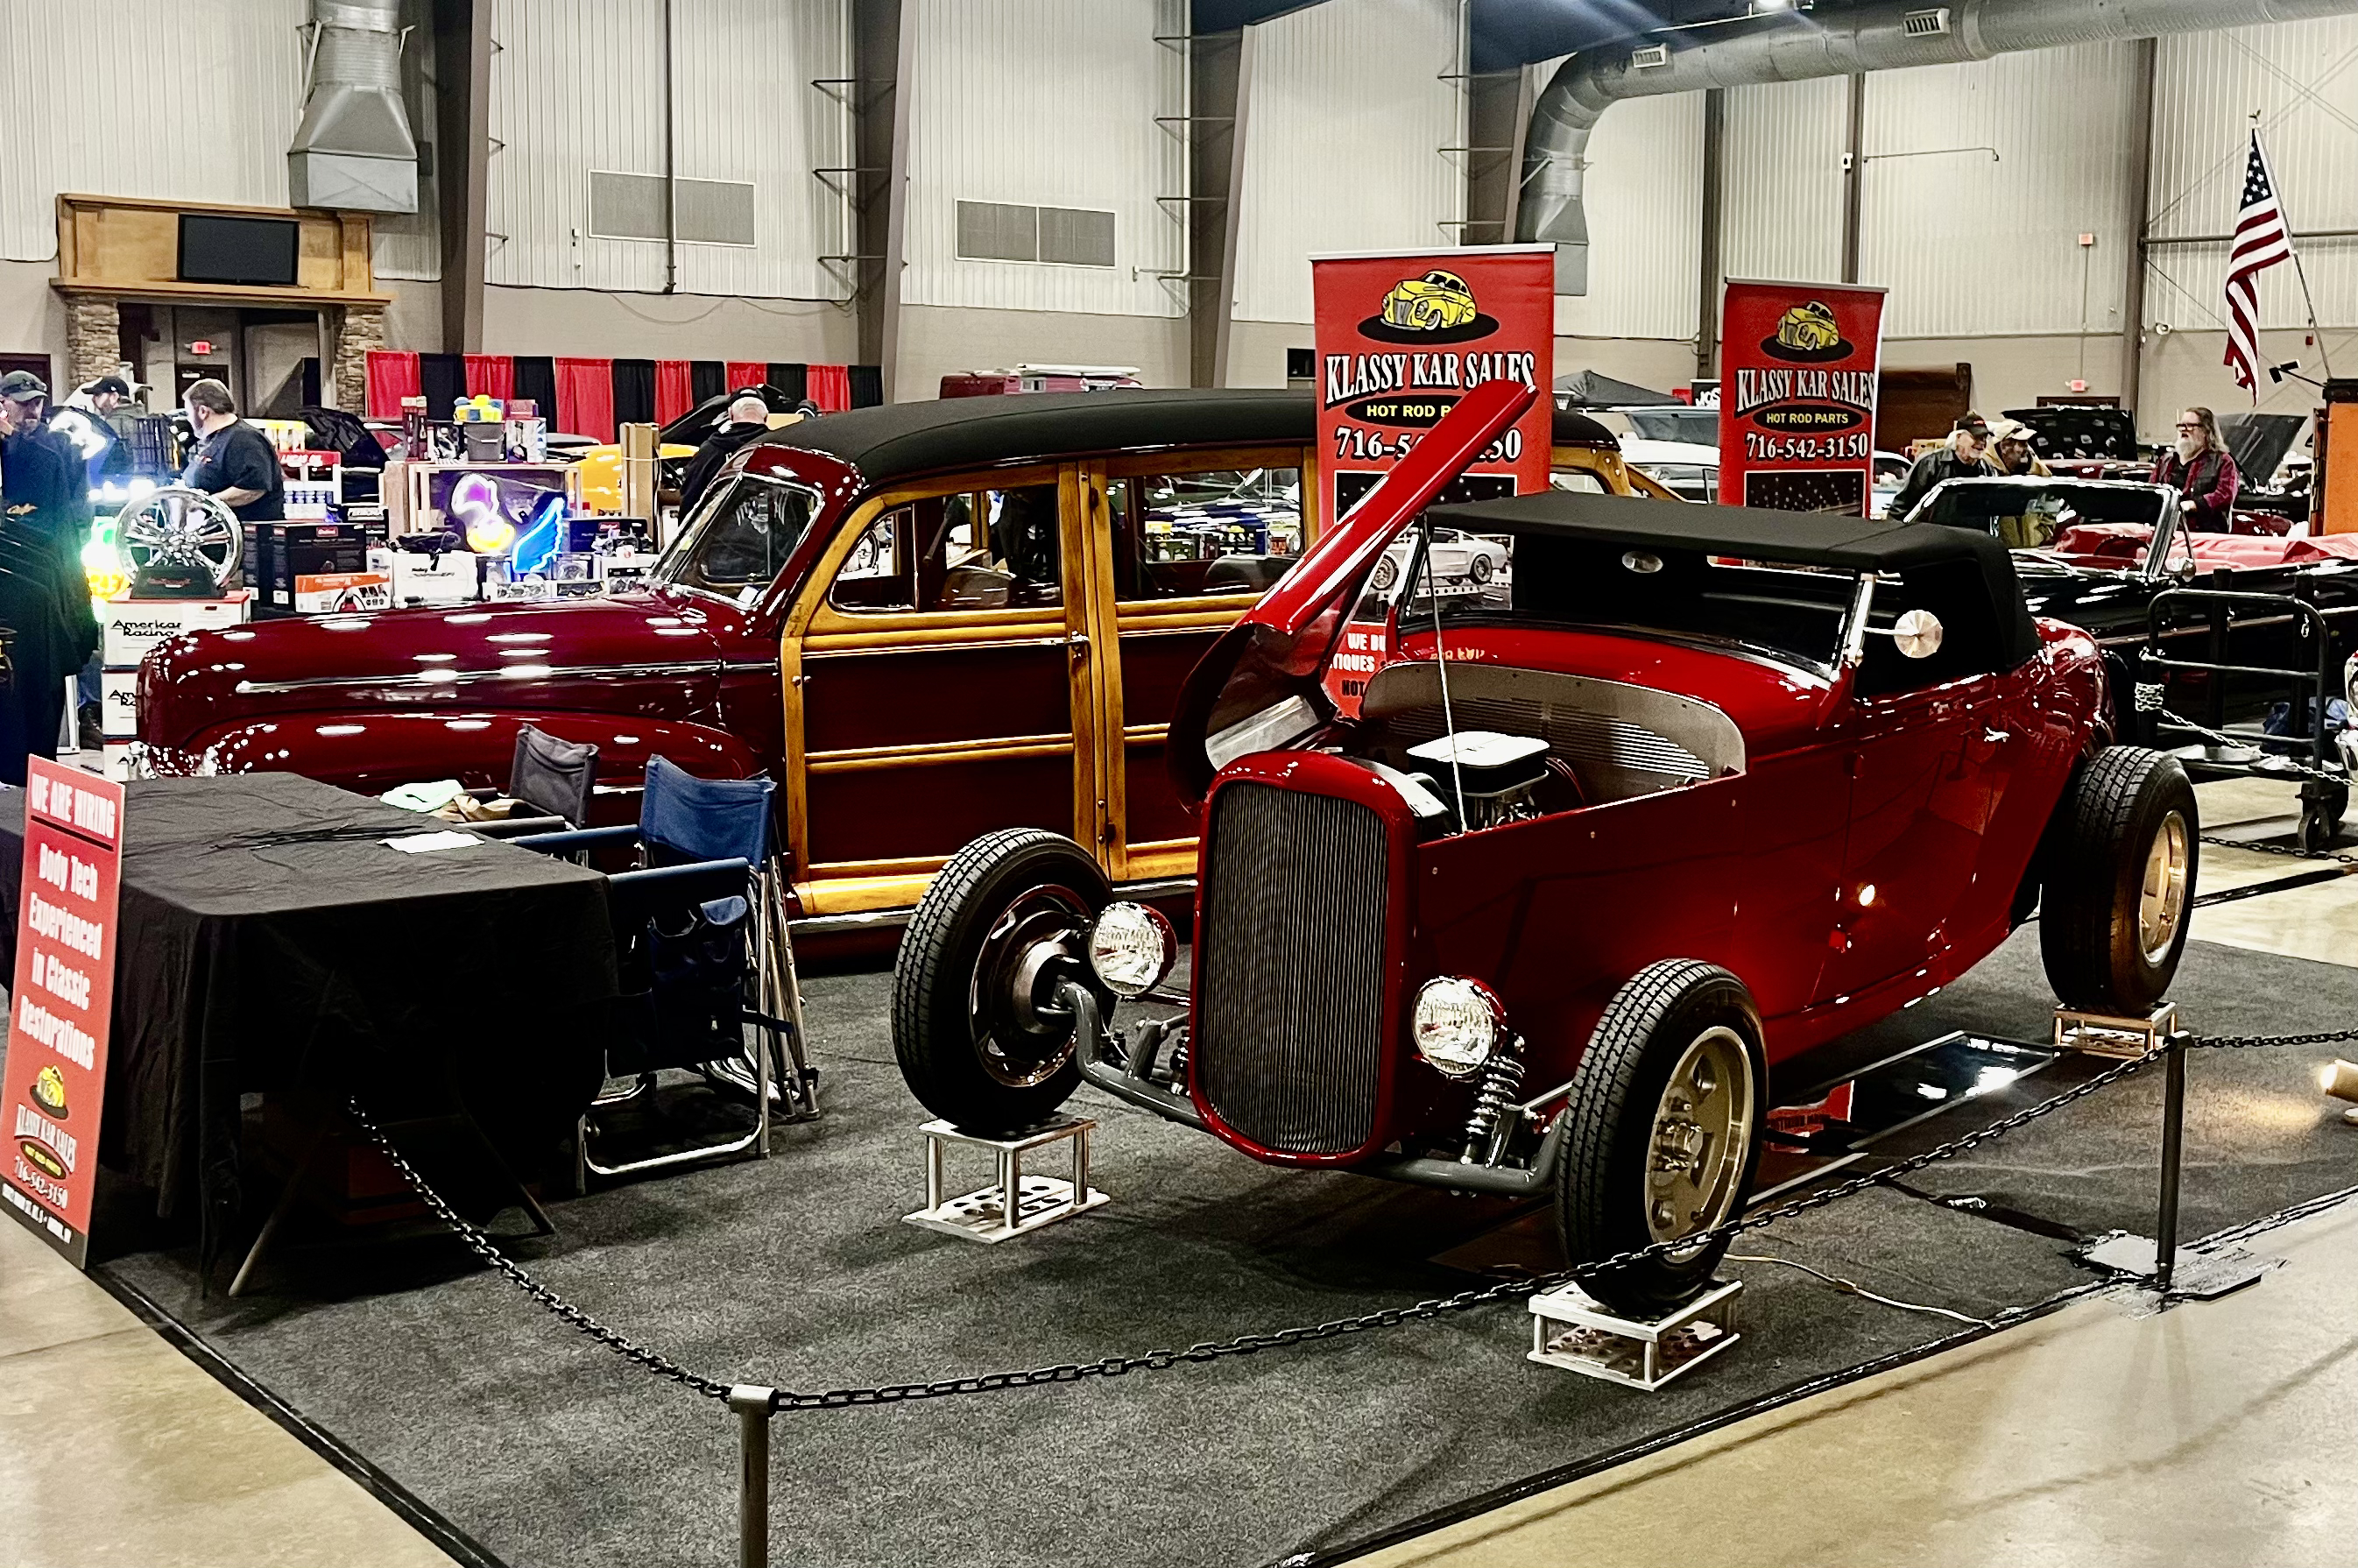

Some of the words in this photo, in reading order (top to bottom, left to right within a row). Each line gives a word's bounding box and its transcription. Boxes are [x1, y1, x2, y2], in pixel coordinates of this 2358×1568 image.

[1325, 354, 1408, 405] KLASSY
[1413, 353, 1460, 386] KAR
[1465, 353, 1535, 389] SALES
[1737, 370, 1793, 413] KLASSY
[1797, 370, 1827, 398] KAR
[1832, 371, 1874, 411] SALES
[1366, 405, 1398, 418] HOT
[1402, 405, 1436, 418] ROD
[1766, 413, 1786, 424] HOT
[1790, 413, 1812, 424] ROD
[1815, 413, 1848, 424] PARTS
[1747, 433, 1867, 457] 716-542-3150
[1330, 653, 1375, 672] TIQUES
[1347, 632, 1367, 650] WE
[1370, 634, 1387, 652] BU
[1342, 680, 1365, 696] HOT
[31, 773, 49, 813] WE
[50, 780, 73, 823] ARE
[74, 788, 116, 839] HIRING
[39, 842, 68, 892] Body
[70, 855, 98, 902] Tech
[29, 892, 102, 961] Experienced
[32, 947, 45, 986] in
[46, 954, 90, 1011] Classic
[19, 994, 95, 1071] Restorations
